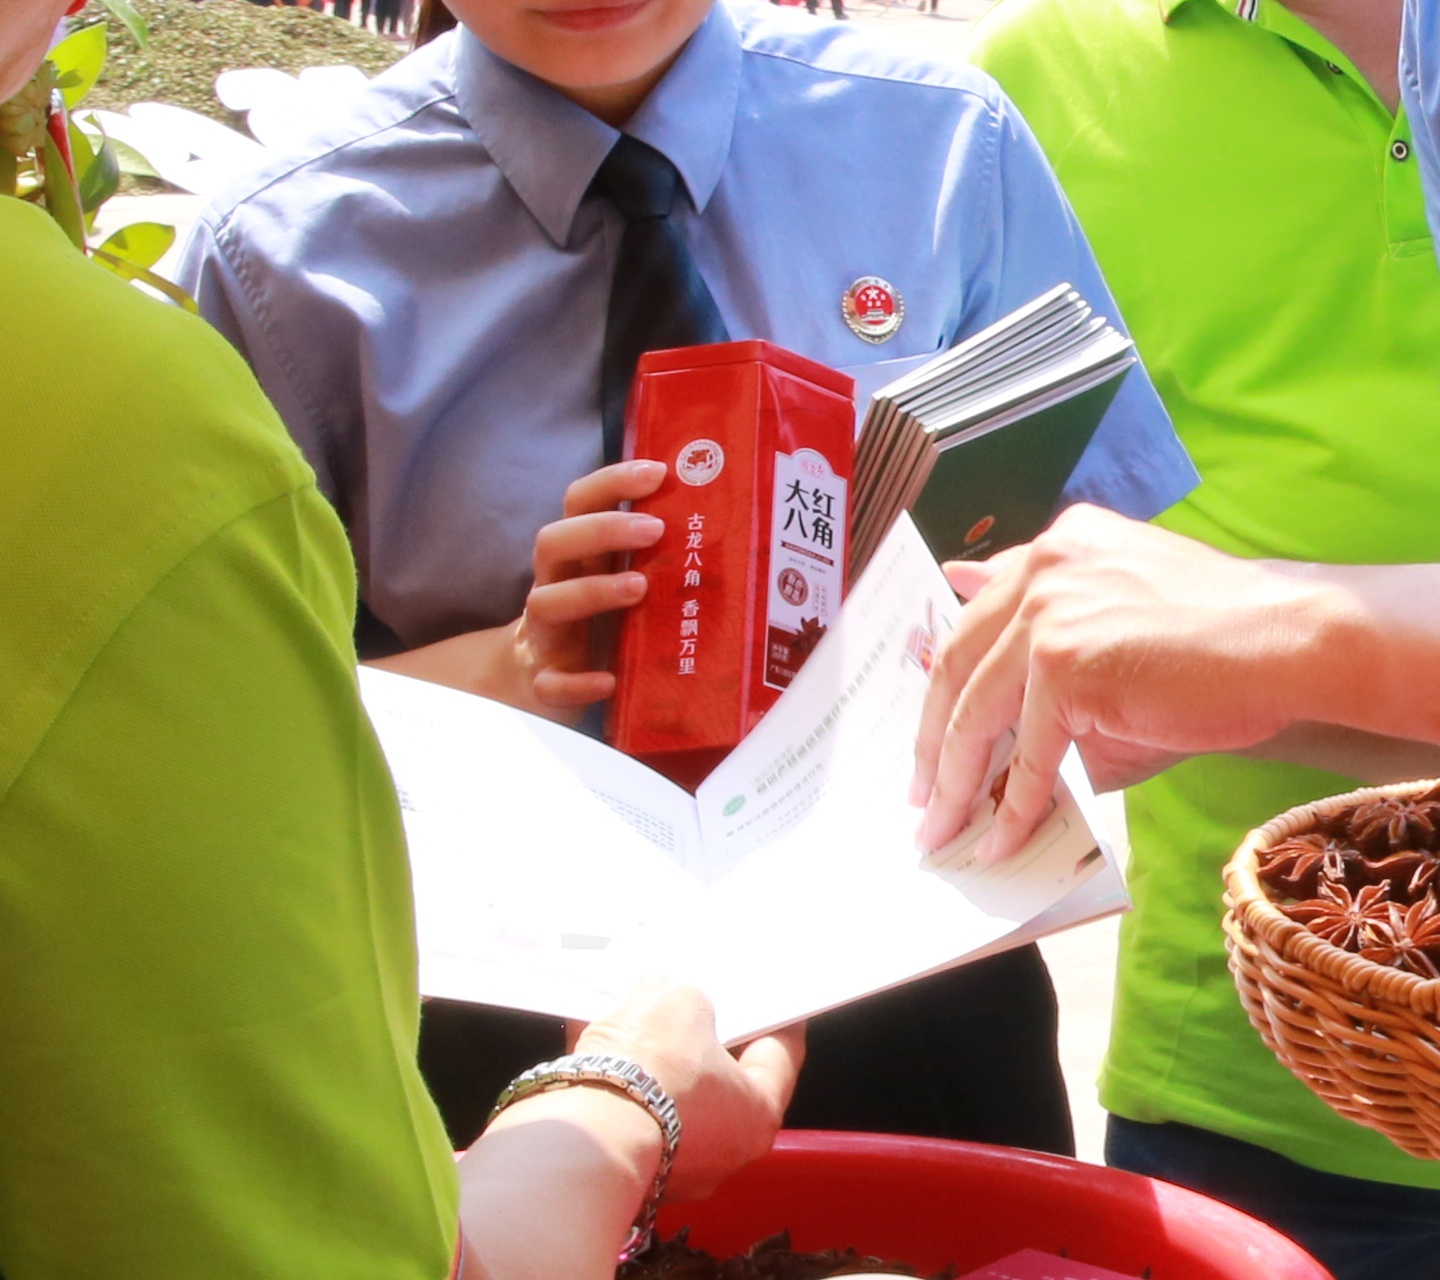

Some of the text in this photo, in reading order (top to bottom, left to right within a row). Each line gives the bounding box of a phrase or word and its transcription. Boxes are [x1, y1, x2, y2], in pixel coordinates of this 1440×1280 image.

[784, 479, 835, 520] 大红
[783, 508, 833, 549] 八角
[677, 513, 706, 676] 古龙八角 香飘万里
